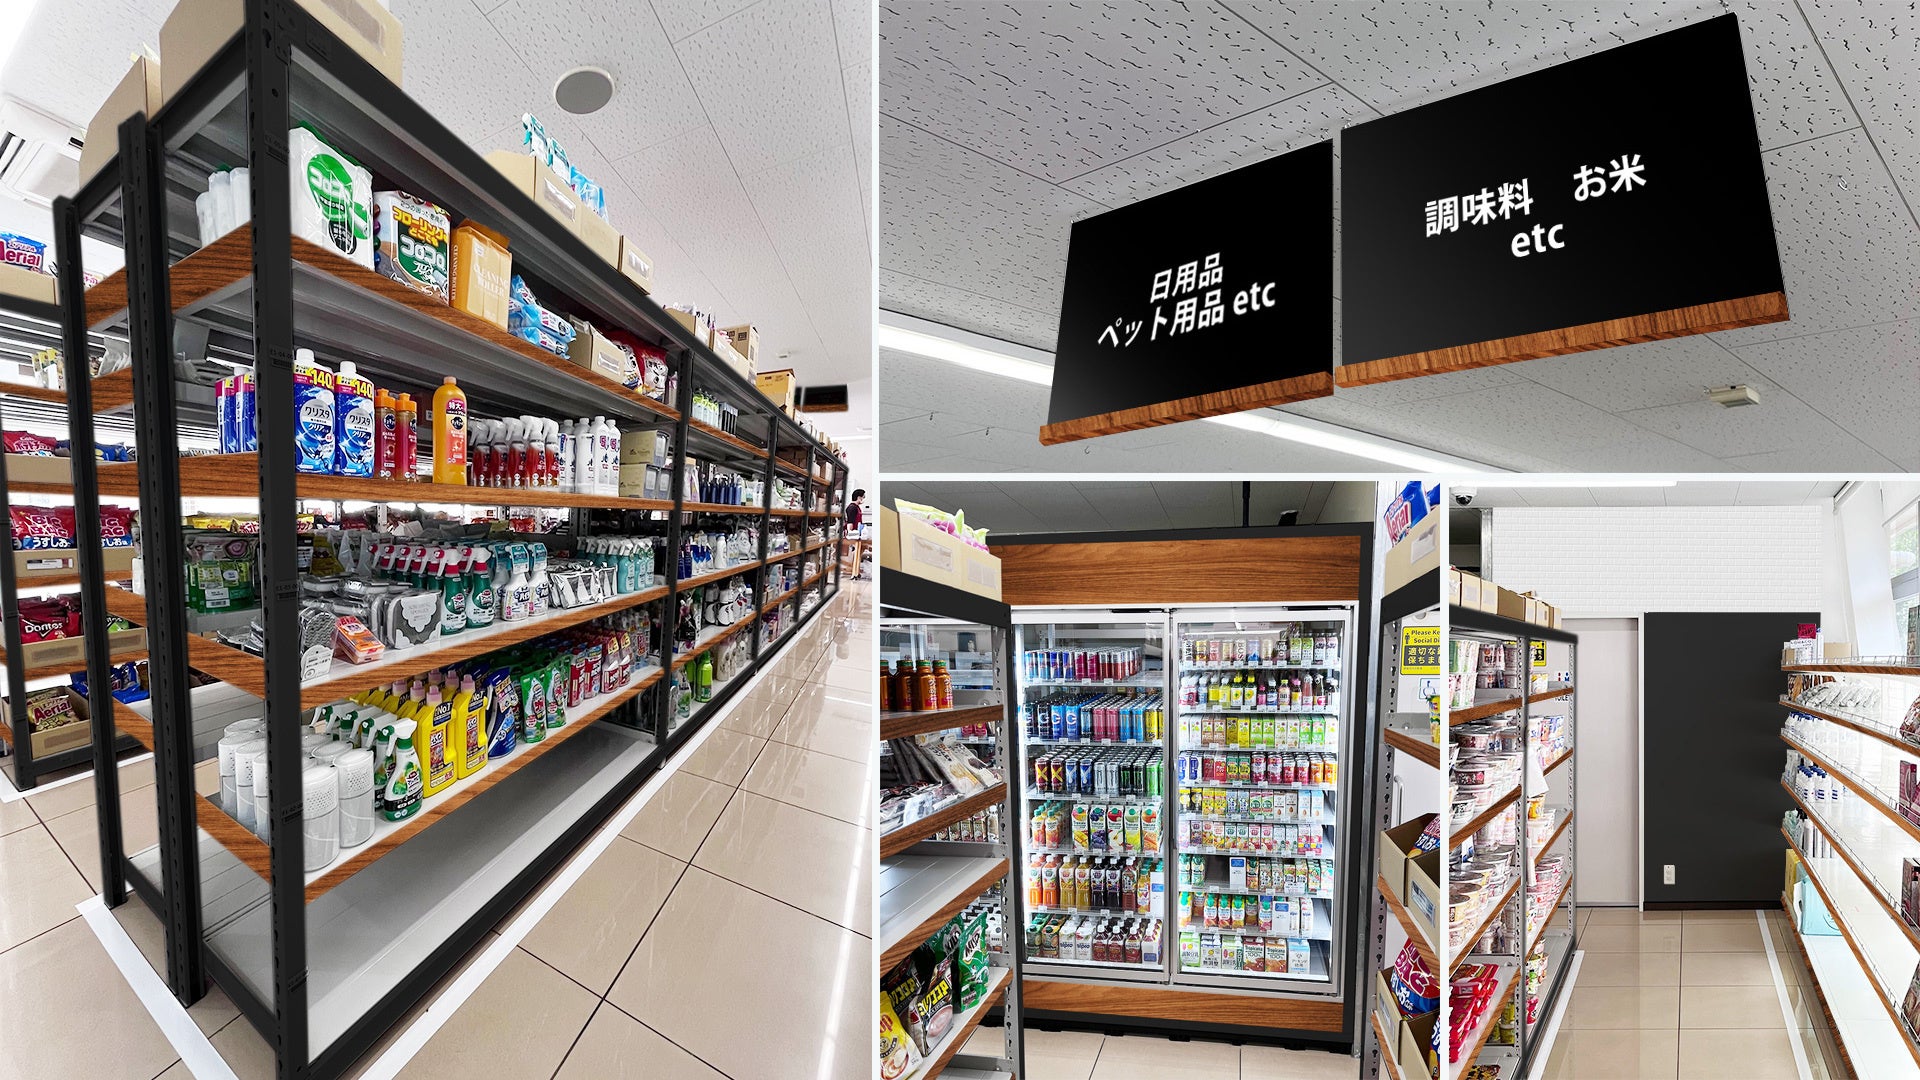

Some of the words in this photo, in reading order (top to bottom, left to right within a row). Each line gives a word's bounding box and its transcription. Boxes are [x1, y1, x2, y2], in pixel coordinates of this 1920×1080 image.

[1424, 178, 1533, 238] 調味料
[1573, 154, 1647, 202] お米
[400, 234, 447, 271] コロコロ
[1510, 222, 1566, 258] etc
[1150, 252, 1224, 304] 日用品
[1097, 288, 1225, 348] ペット用品
[1233, 282, 1276, 315] etc
[305, 406, 330, 419] クリスタ
[349, 414, 371, 426] クリスタ
[31, 515, 62, 528] BIG
[25, 622, 63, 633] Doritos
[33, 700, 71, 725] Aerial
